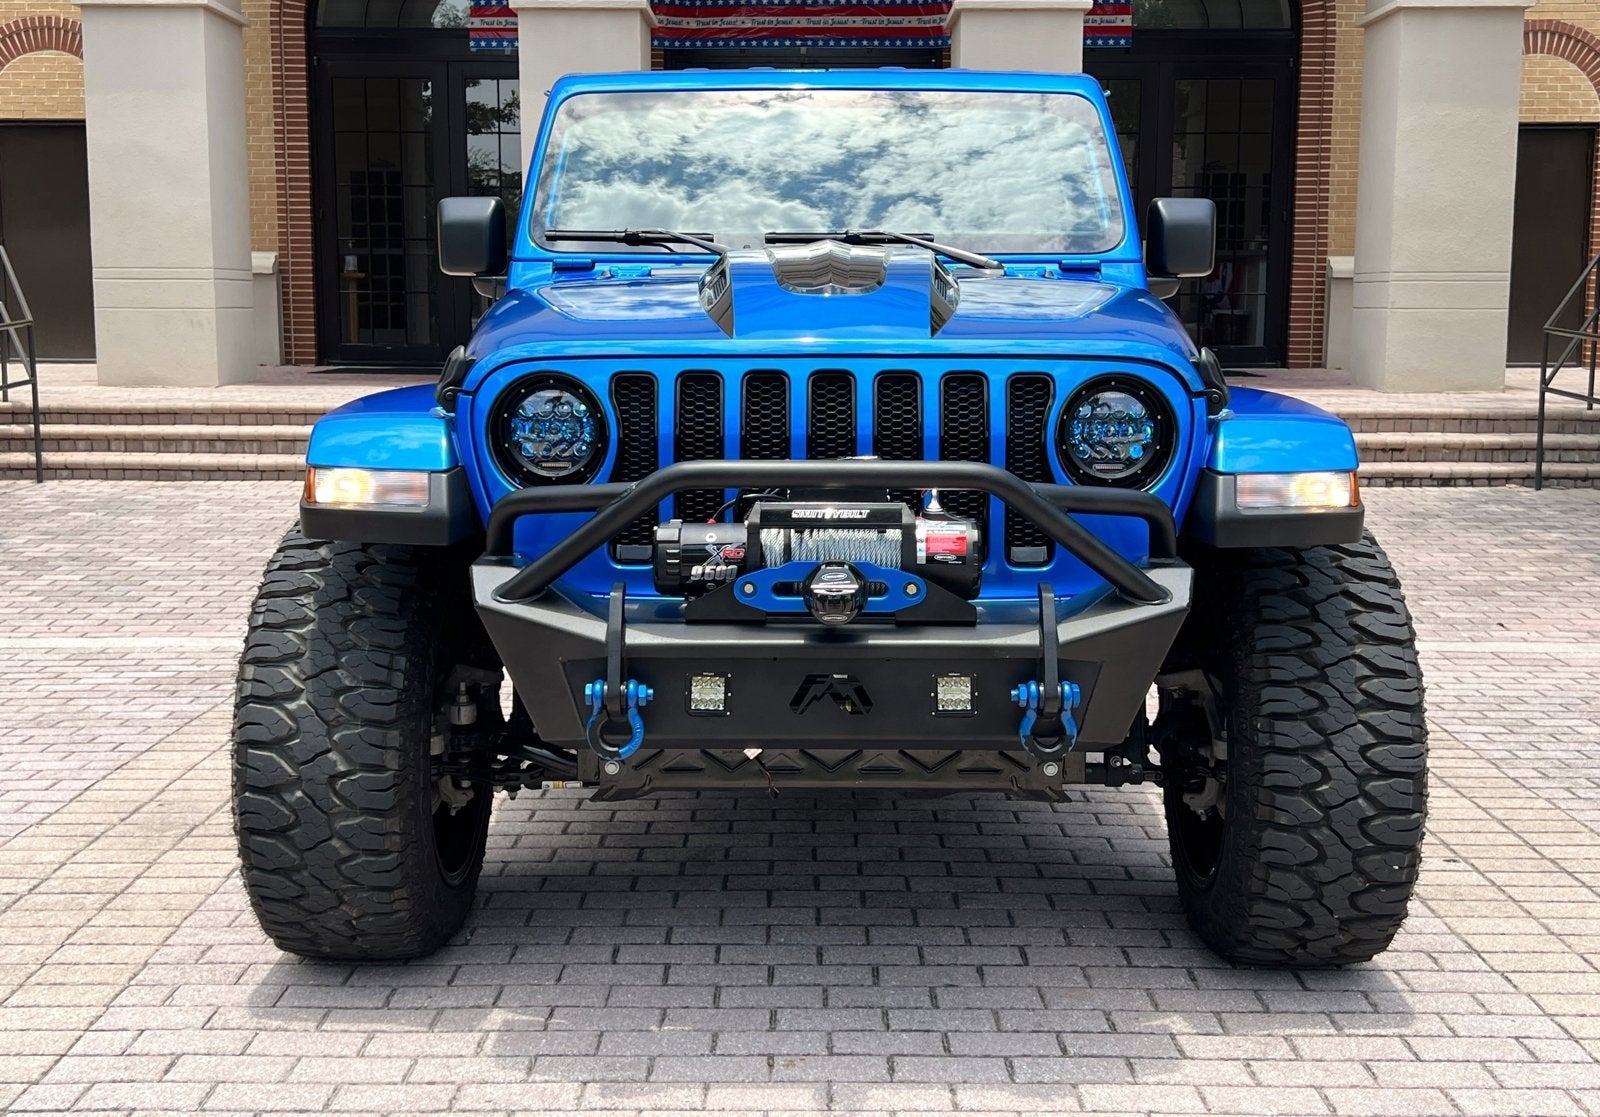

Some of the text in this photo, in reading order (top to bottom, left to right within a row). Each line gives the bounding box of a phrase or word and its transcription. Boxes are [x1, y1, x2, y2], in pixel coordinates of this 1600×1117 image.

[480, 18, 495, 26] Trust
[503, 18, 518, 27] Jesu
[665, 18, 684, 26] Jesus!
[718, 18, 738, 27] Jesus!
[751, 18, 767, 26] Trust
[774, 18, 794, 26] Jesus!
[829, 18, 849, 26] Jesus!
[862, 17, 877, 25] Trust
[885, 17, 905, 26] Jesus!
[916, 17, 931, 25] Trust
[1098, 17, 1118, 25] Jesus!
